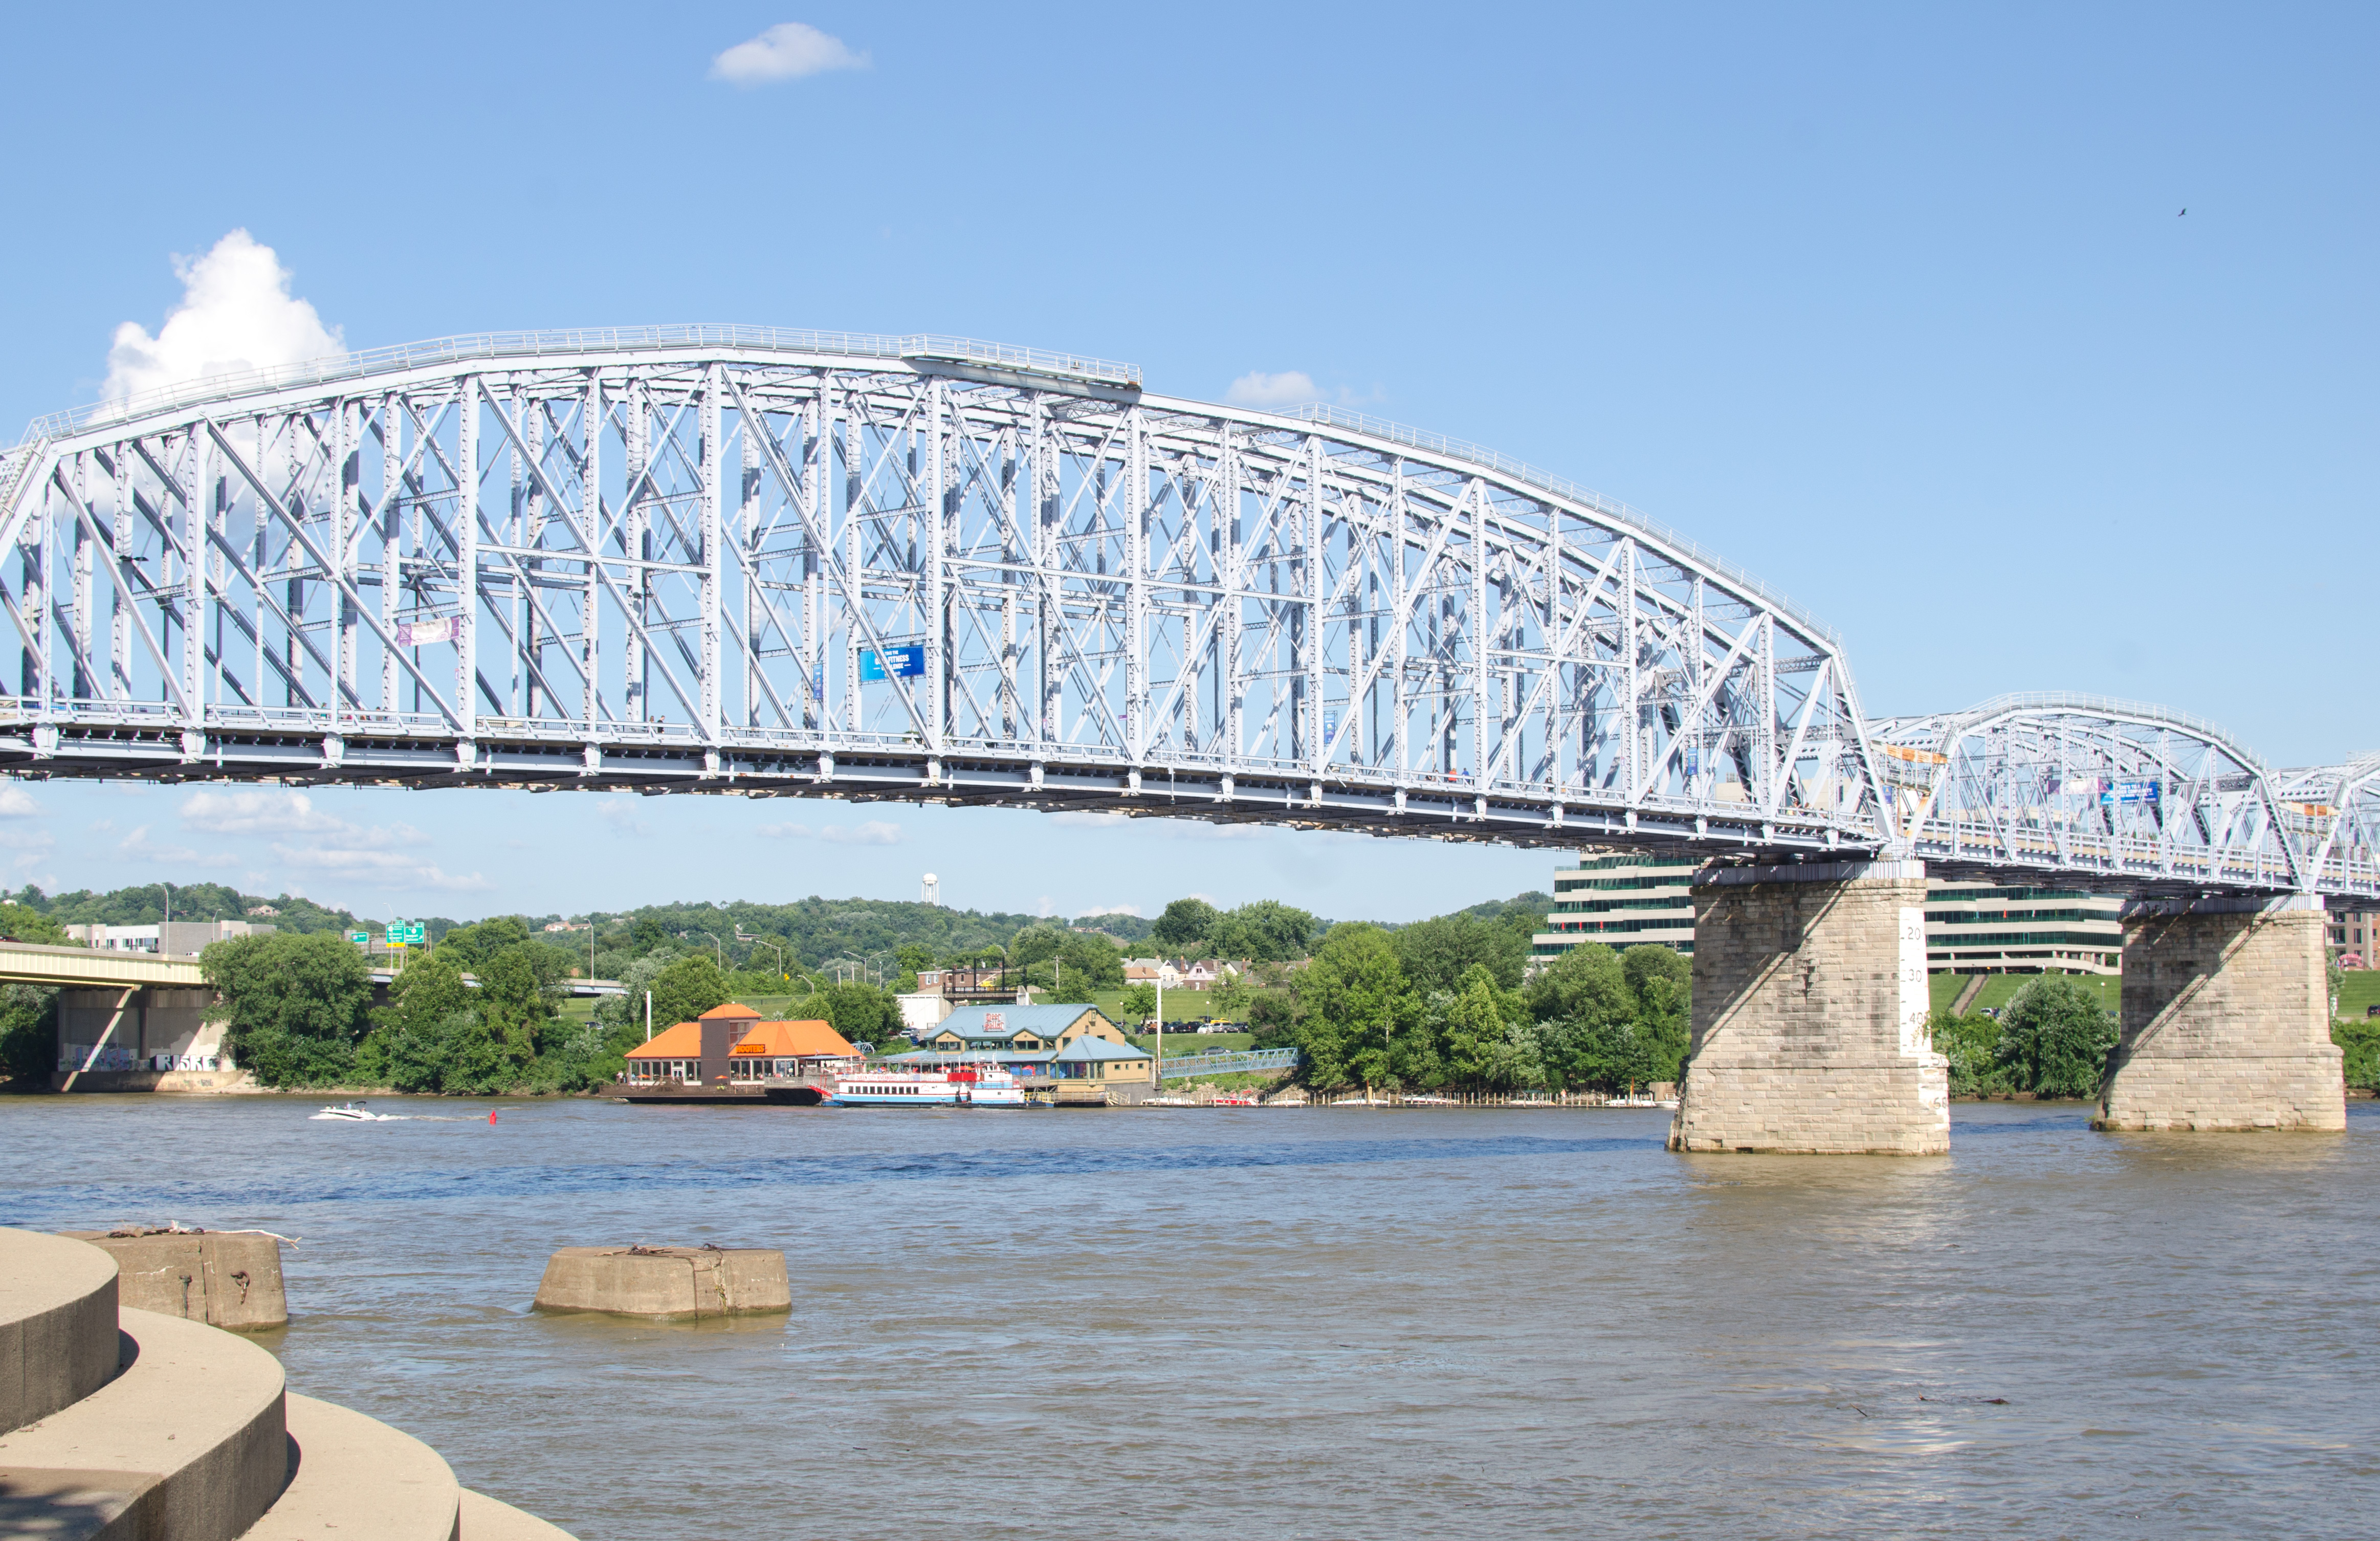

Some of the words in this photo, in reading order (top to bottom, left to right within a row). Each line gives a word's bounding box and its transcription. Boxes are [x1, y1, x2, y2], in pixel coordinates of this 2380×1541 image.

[888, 654, 910, 664] FITNESS
[1908, 927, 1921, 940] 20
[1908, 968, 1922, 982] 30
[986, 1013, 1001, 1022] Beer
[1909, 1012, 1923, 1025] 40
[736, 1045, 764, 1053] HOOTERS
[1931, 1055, 1947, 1067] 50
